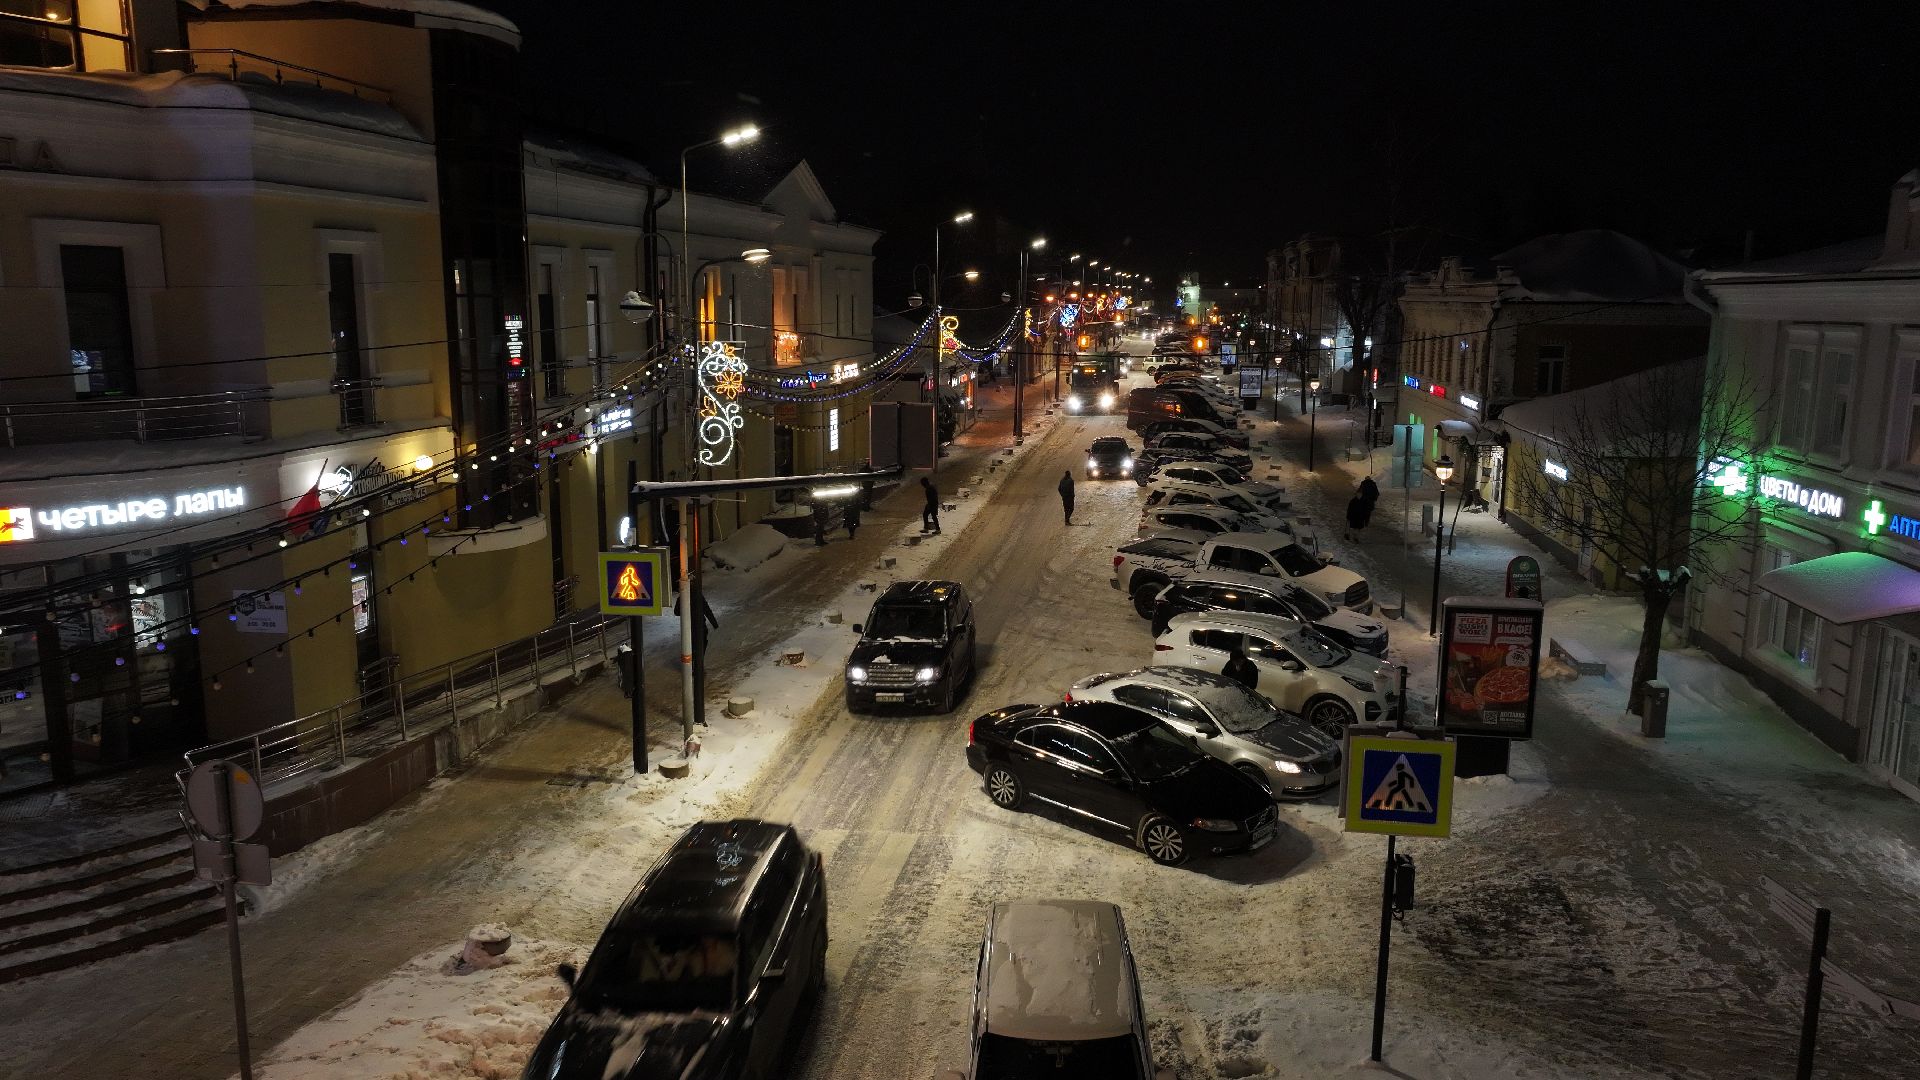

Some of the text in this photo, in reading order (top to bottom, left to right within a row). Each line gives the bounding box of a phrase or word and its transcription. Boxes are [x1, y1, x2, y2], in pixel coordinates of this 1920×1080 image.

[38, 486, 244, 531] четыре лапы
[1760, 475, 1843, 518] ЦВЕТЫ в ДОМ
[1888, 514, 1920, 541] АПТ
[1497, 623, 1503, 634] В
